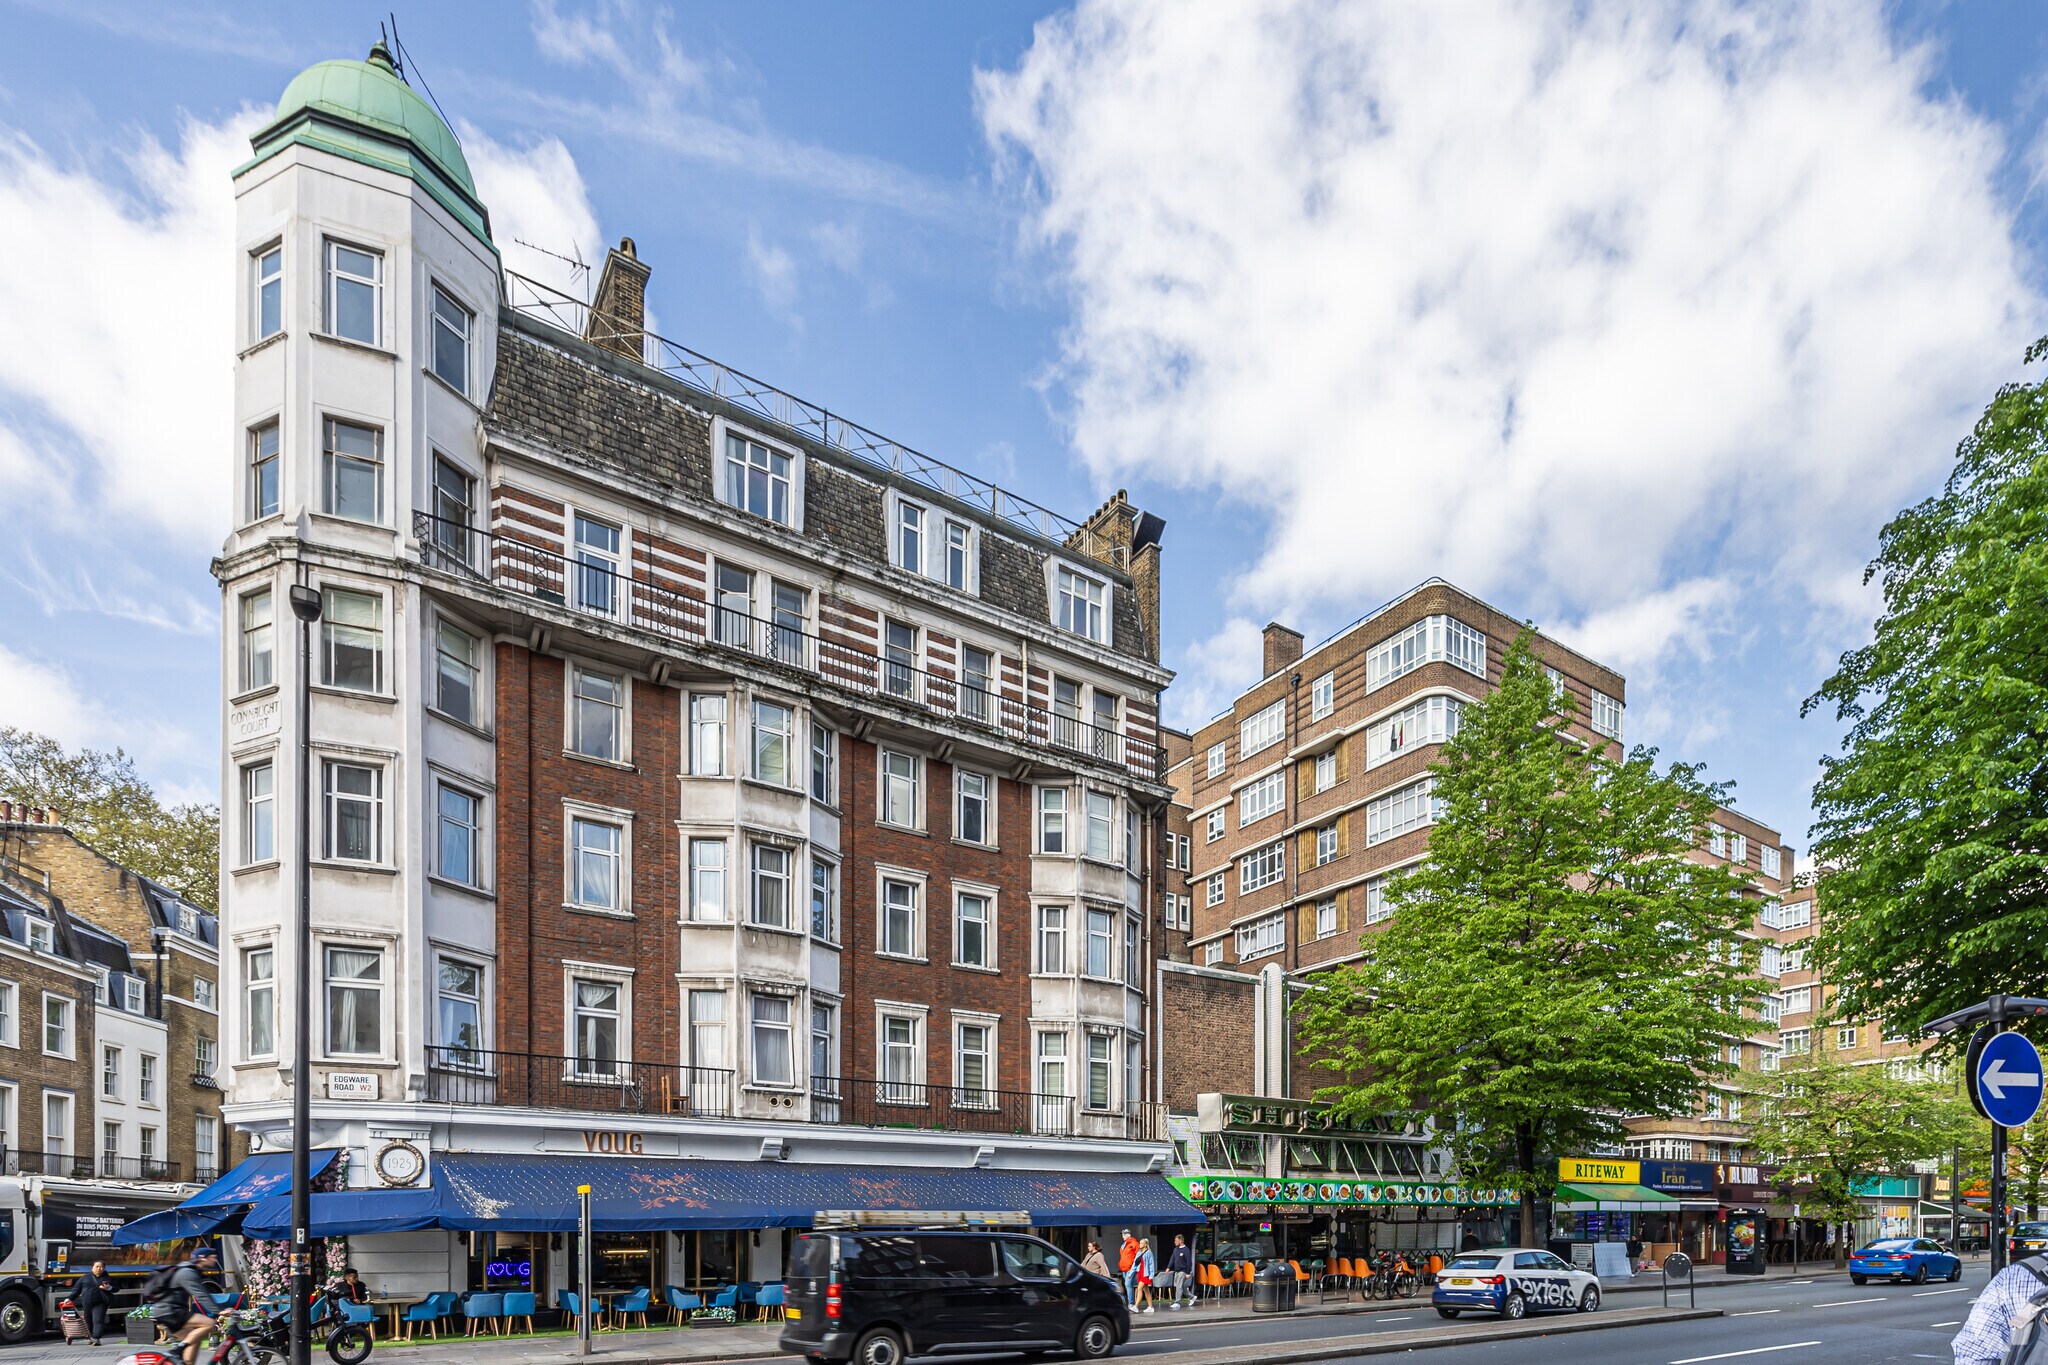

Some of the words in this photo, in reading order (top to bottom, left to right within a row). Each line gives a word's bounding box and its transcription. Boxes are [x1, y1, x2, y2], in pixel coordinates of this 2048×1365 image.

[231, 701, 279, 725] CONNAUGHT
[241, 717, 269, 735] COURT
[334, 1075, 370, 1084] EDGWARE
[334, 1083, 355, 1091] ROAD
[582, 1131, 643, 1155] VOUG
[388, 1157, 412, 1169] 1925
[1575, 1163, 1626, 1179] RITEWAY
[1661, 1171, 1685, 1184] Iran
[1729, 1166, 1741, 1184] AL
[1741, 1167, 1759, 1185] DAR
[1506, 1276, 1577, 1308] Dexters
